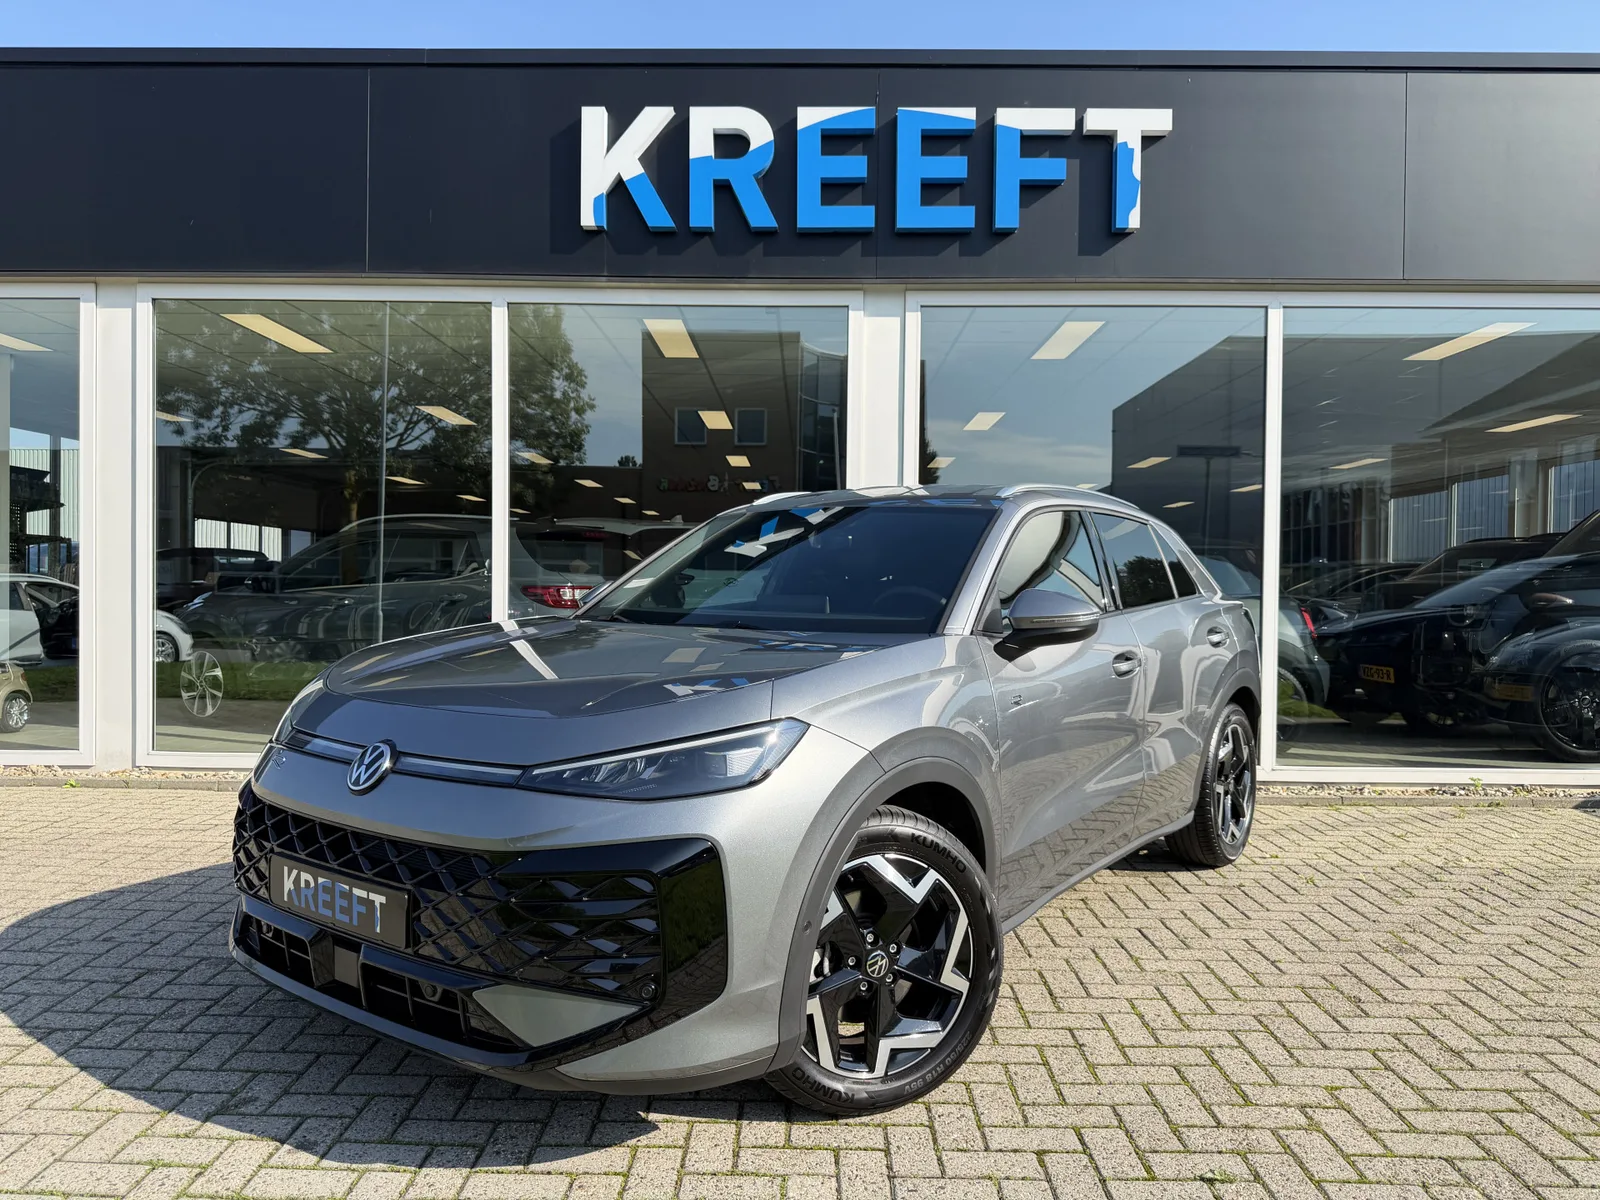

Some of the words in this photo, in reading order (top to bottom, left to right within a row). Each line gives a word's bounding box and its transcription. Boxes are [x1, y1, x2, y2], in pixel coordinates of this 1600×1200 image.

[580, 106, 1173, 233] KREEFT
[910, 832, 967, 873] KUMHO
[283, 865, 387, 934] KREEFT
[791, 1066, 856, 1103] KUMHO
[904, 1078, 924, 1095] 95V
[925, 1063, 945, 1082] R18
